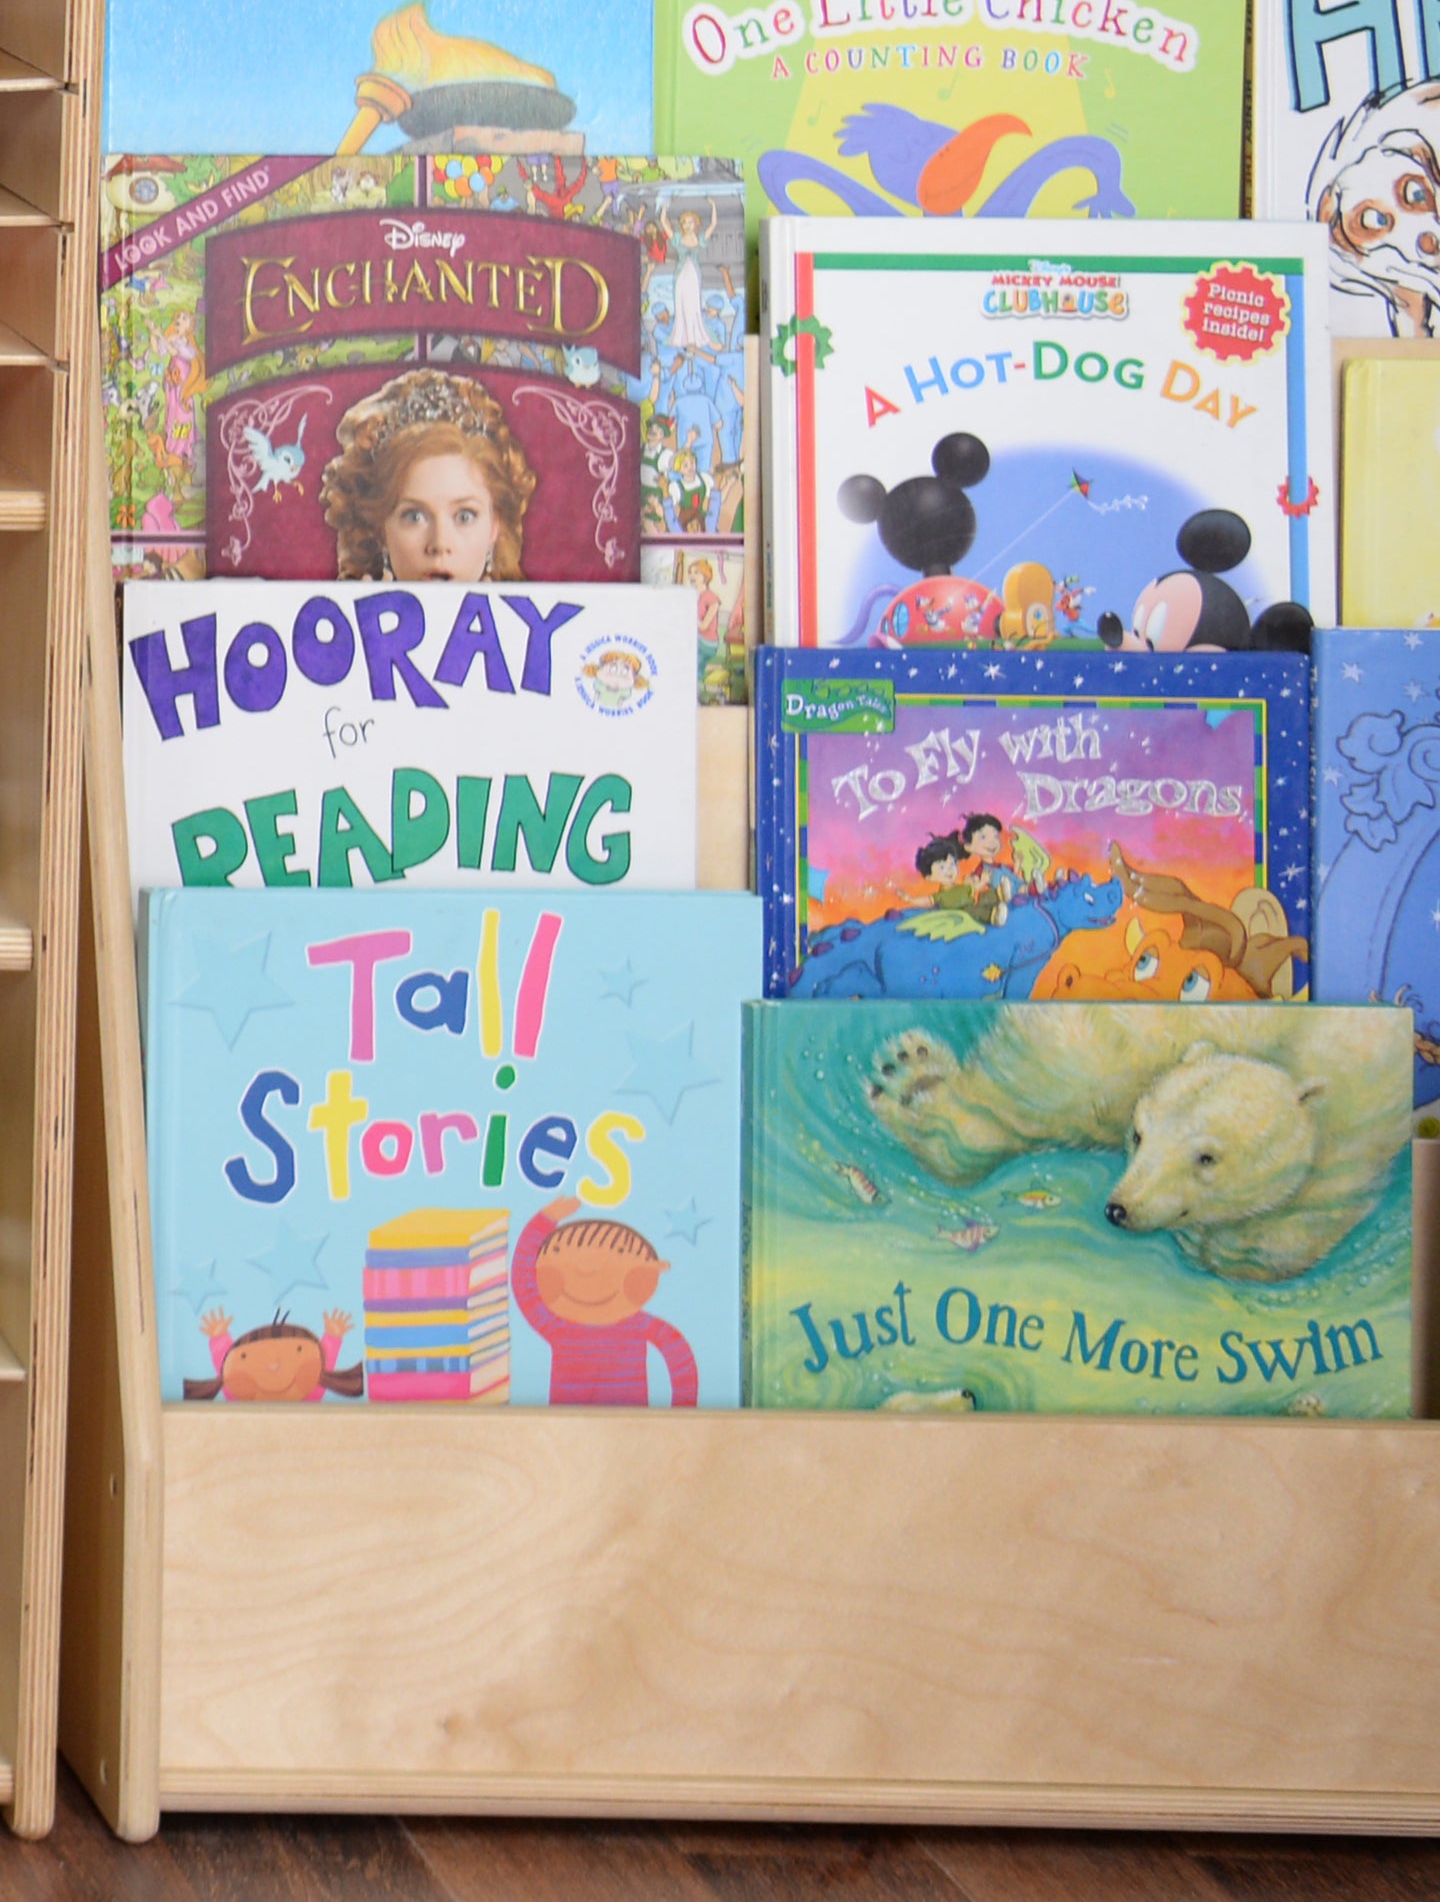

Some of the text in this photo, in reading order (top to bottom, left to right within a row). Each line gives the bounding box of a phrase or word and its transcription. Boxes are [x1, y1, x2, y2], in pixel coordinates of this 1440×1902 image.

[689, 11, 796, 65] One
[772, 45, 1089, 80] A COUNTING BOOK
[115, 169, 269, 271] LOOK AND FIND
[240, 256, 610, 345] ENCHANTED
[991, 274, 1053, 287] MICKEY
[1208, 282, 1266, 308] Picnic
[1202, 301, 1271, 328] recipes
[1202, 317, 1265, 343] inside!
[864, 385, 902, 428] A
[1160, 359, 1258, 430] DAY
[129, 590, 586, 742] HOORAY
[322, 706, 376, 760] for
[785, 693, 855, 721] Dragon
[831, 712, 1103, 821] To Fly with
[1016, 770, 1243, 819] Dragons
[171, 766, 632, 889] READING
[307, 908, 563, 1062] Tall
[223, 1064, 647, 1206] Stories
[789, 1280, 1384, 1386] Just One More Swim
